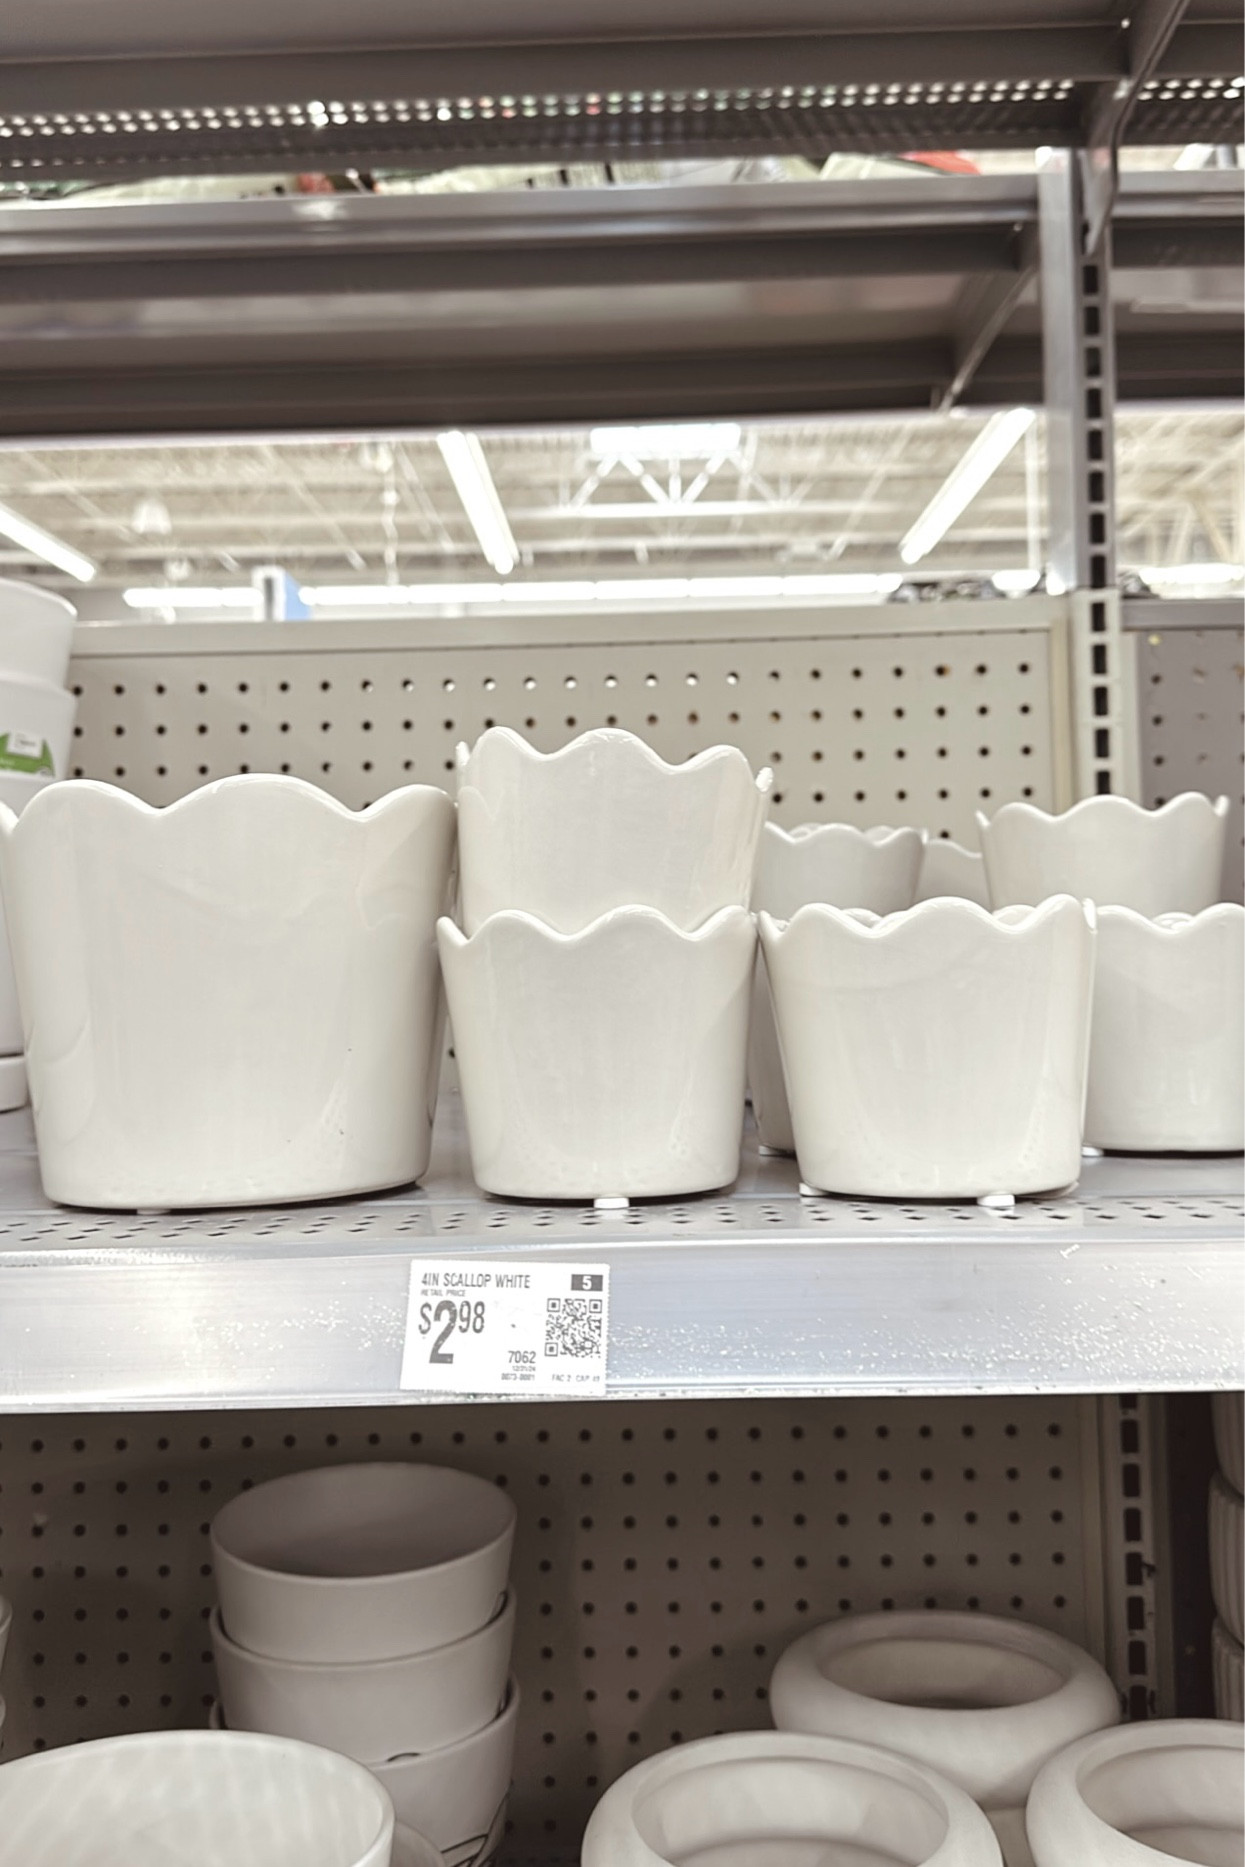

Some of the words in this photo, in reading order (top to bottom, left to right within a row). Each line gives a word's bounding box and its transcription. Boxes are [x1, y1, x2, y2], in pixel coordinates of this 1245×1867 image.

[421, 1272, 440, 1287] 4IN
[443, 1273, 492, 1288] SCALLOP
[496, 1274, 531, 1289] WHITE
[581, 1275, 593, 1290] 5
[420, 1288, 443, 1297] RETAIL
[446, 1289, 466, 1298] PRICE
[508, 1350, 537, 1365] 7062
